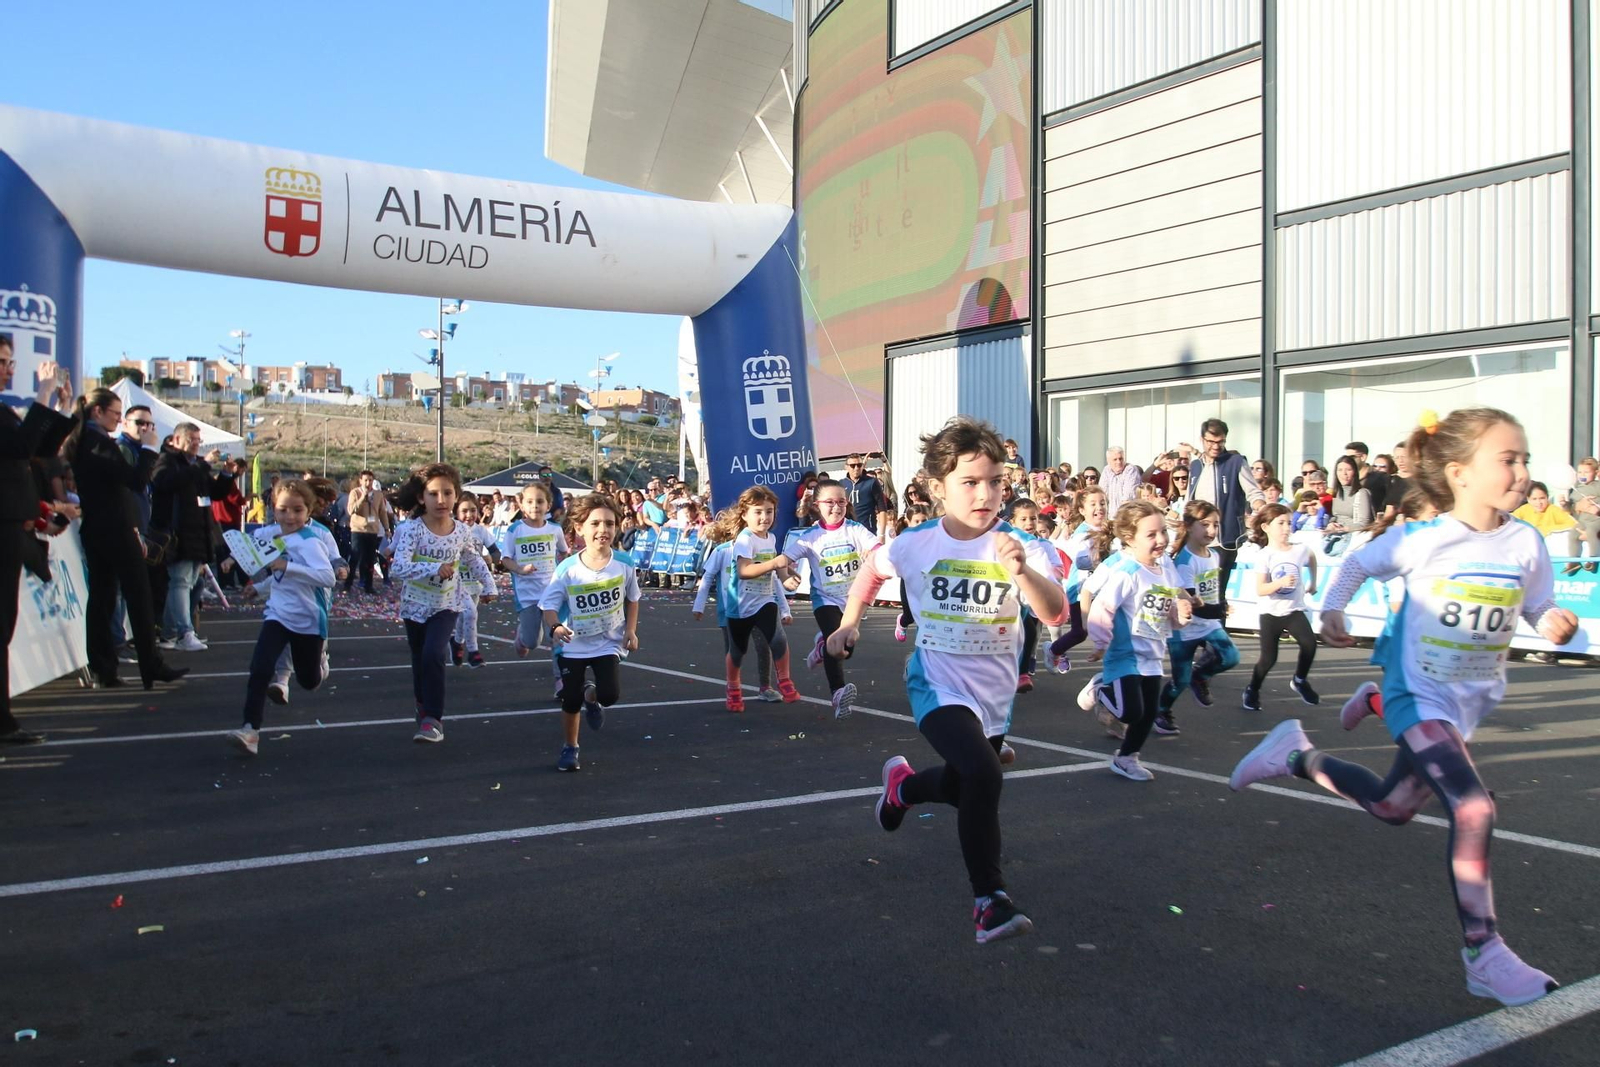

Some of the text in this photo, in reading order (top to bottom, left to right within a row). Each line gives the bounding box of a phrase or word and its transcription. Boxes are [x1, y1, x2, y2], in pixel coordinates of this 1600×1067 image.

[375, 186, 597, 248] ALMERÍA
[373, 233, 489, 269] CIUDAD
[730, 446, 815, 474] ALMERÍA
[753, 471, 802, 486] CIUDAD
[520, 541, 552, 555] 8051
[825, 559, 859, 577] 8418
[576, 587, 620, 609] 8086
[931, 576, 1012, 605] 8407
[939, 602, 999, 614] MI CHURRILLA
